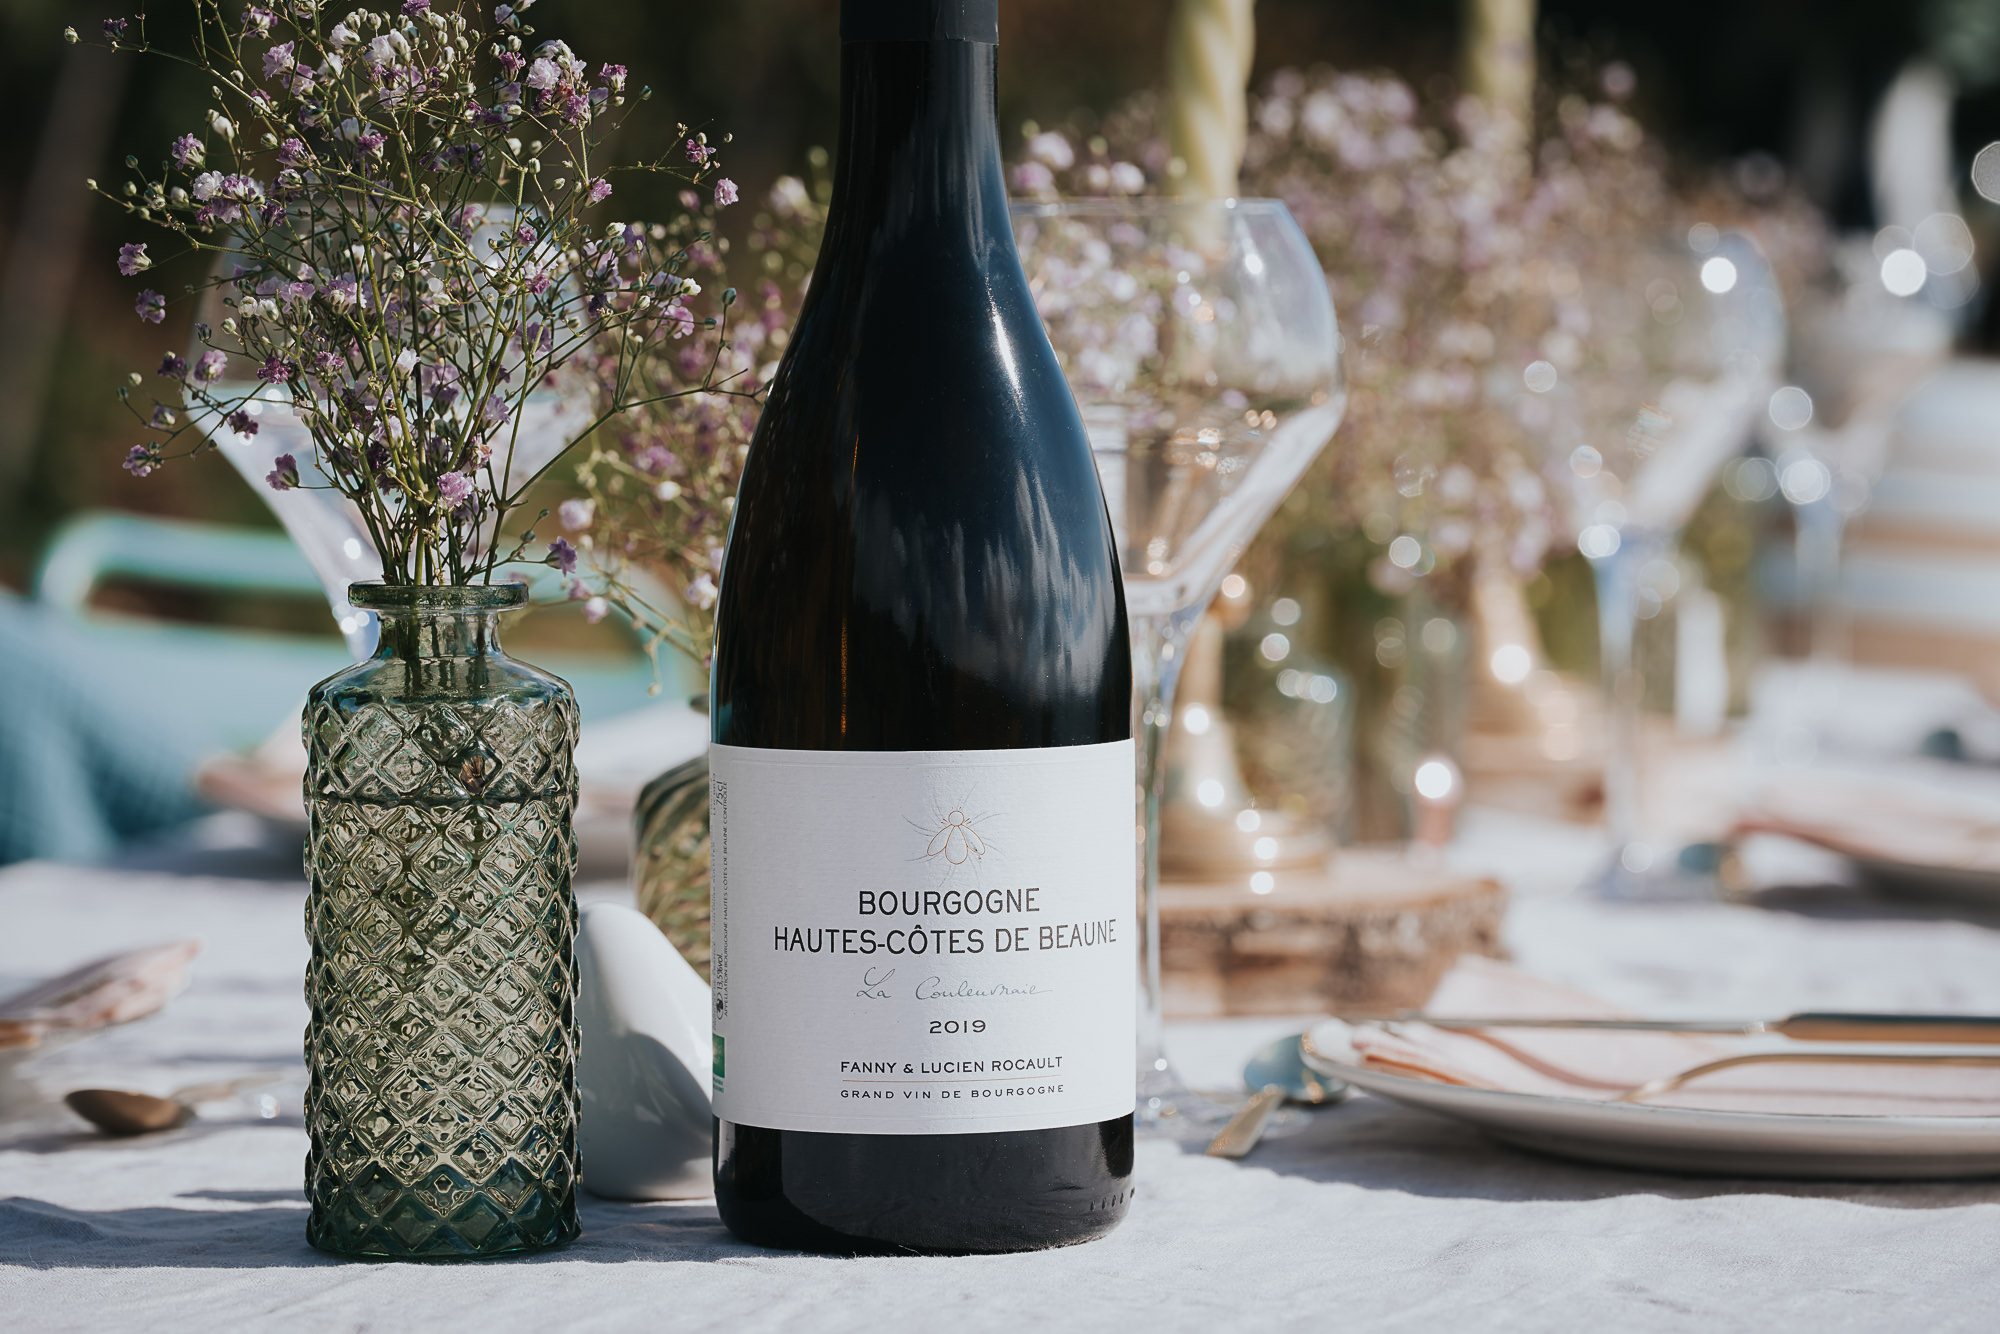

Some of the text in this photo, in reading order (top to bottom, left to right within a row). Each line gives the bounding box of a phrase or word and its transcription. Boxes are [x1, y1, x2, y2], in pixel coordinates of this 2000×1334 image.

[716, 781, 724, 805] 75cl
[859, 888, 1040, 917] BOURGOGNE
[775, 919, 1116, 954] HAUTES-CÔTES DE BEAUNE
[857, 967, 895, 999] La
[930, 1020, 986, 1034] 2019
[841, 1056, 1062, 1073] FANNY & LUCIEN ROCAULT
[841, 1090, 894, 1099] GRAND
[903, 1091, 930, 1099] VIN
[971, 1085, 1063, 1098] BOURGOGNE
